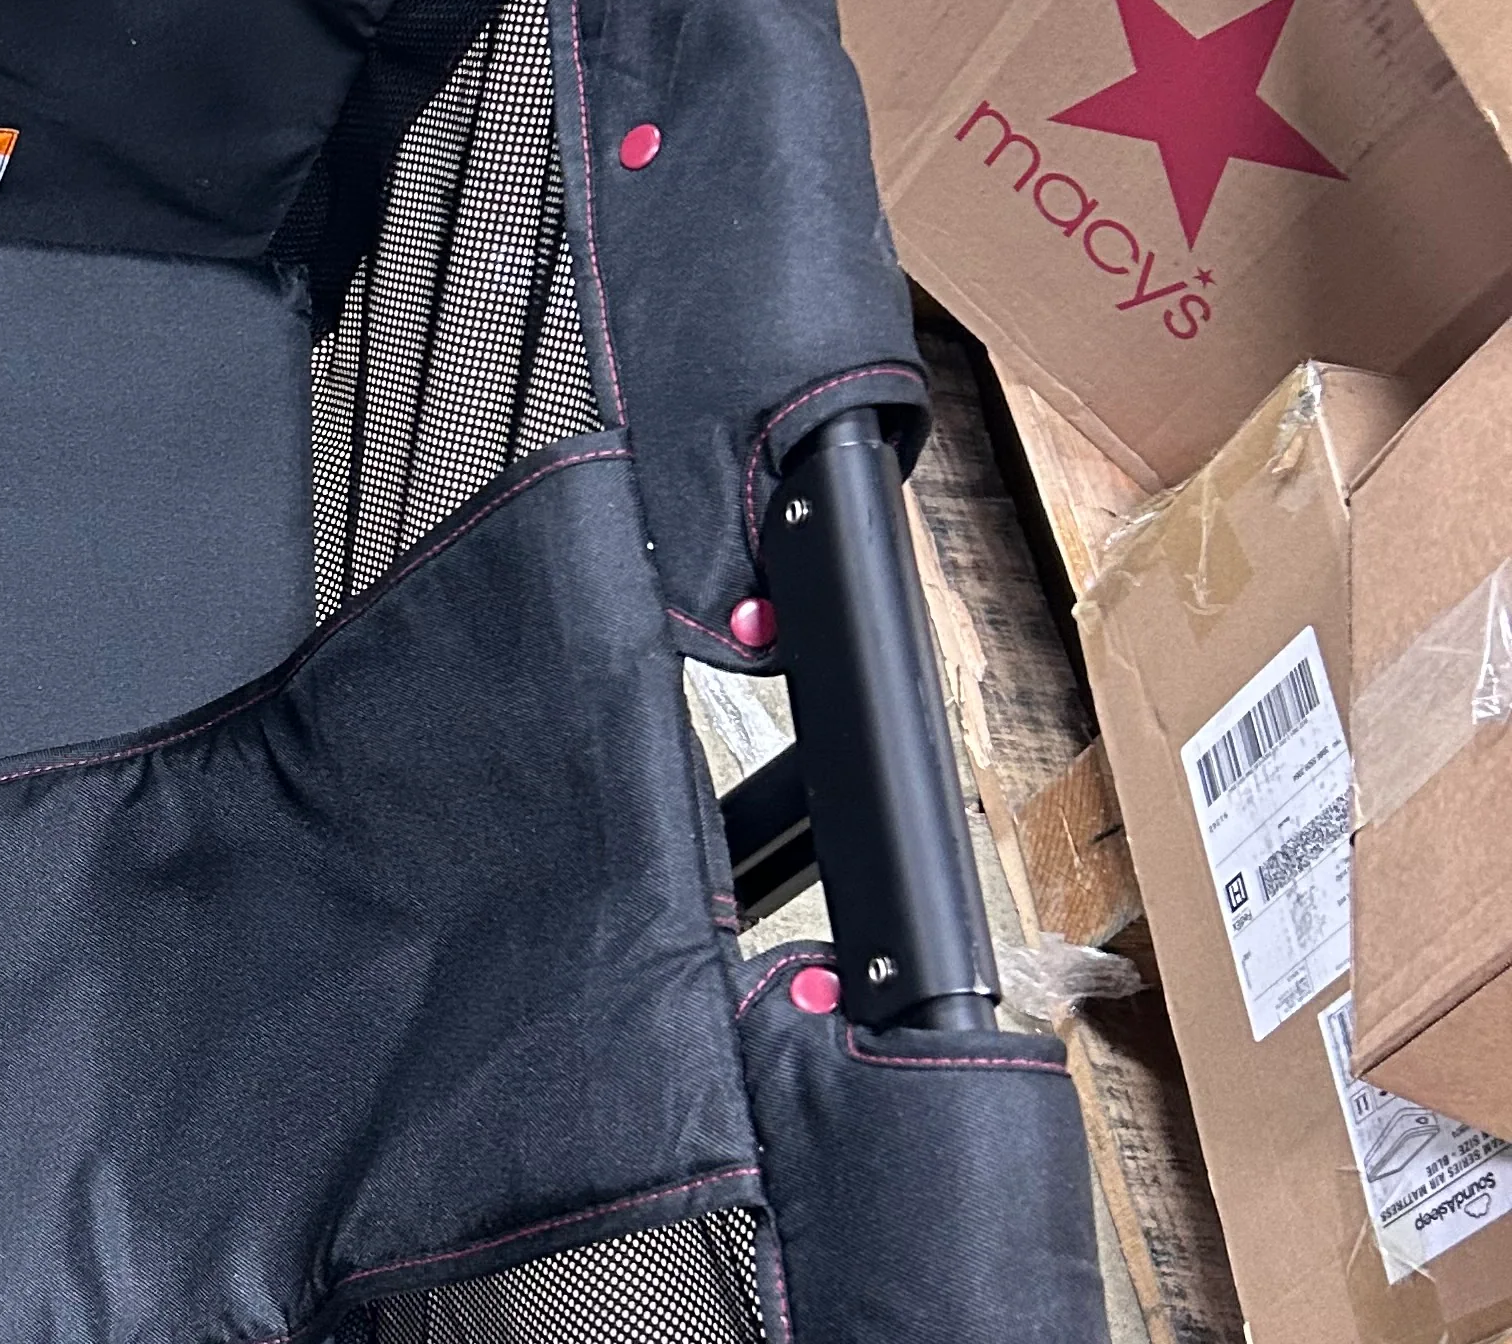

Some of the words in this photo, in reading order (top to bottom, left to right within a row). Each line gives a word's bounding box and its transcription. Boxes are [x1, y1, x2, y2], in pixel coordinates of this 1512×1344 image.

[1457, 1134, 1480, 1156] SIZE
[1425, 1154, 1450, 1178] BLUE
[1447, 1149, 1481, 1178] SERIES
[1428, 1171, 1446, 1190] AIR
[1379, 1183, 1428, 1222] MATTRESS
[1414, 1171, 1497, 1231] SoundAsleep
